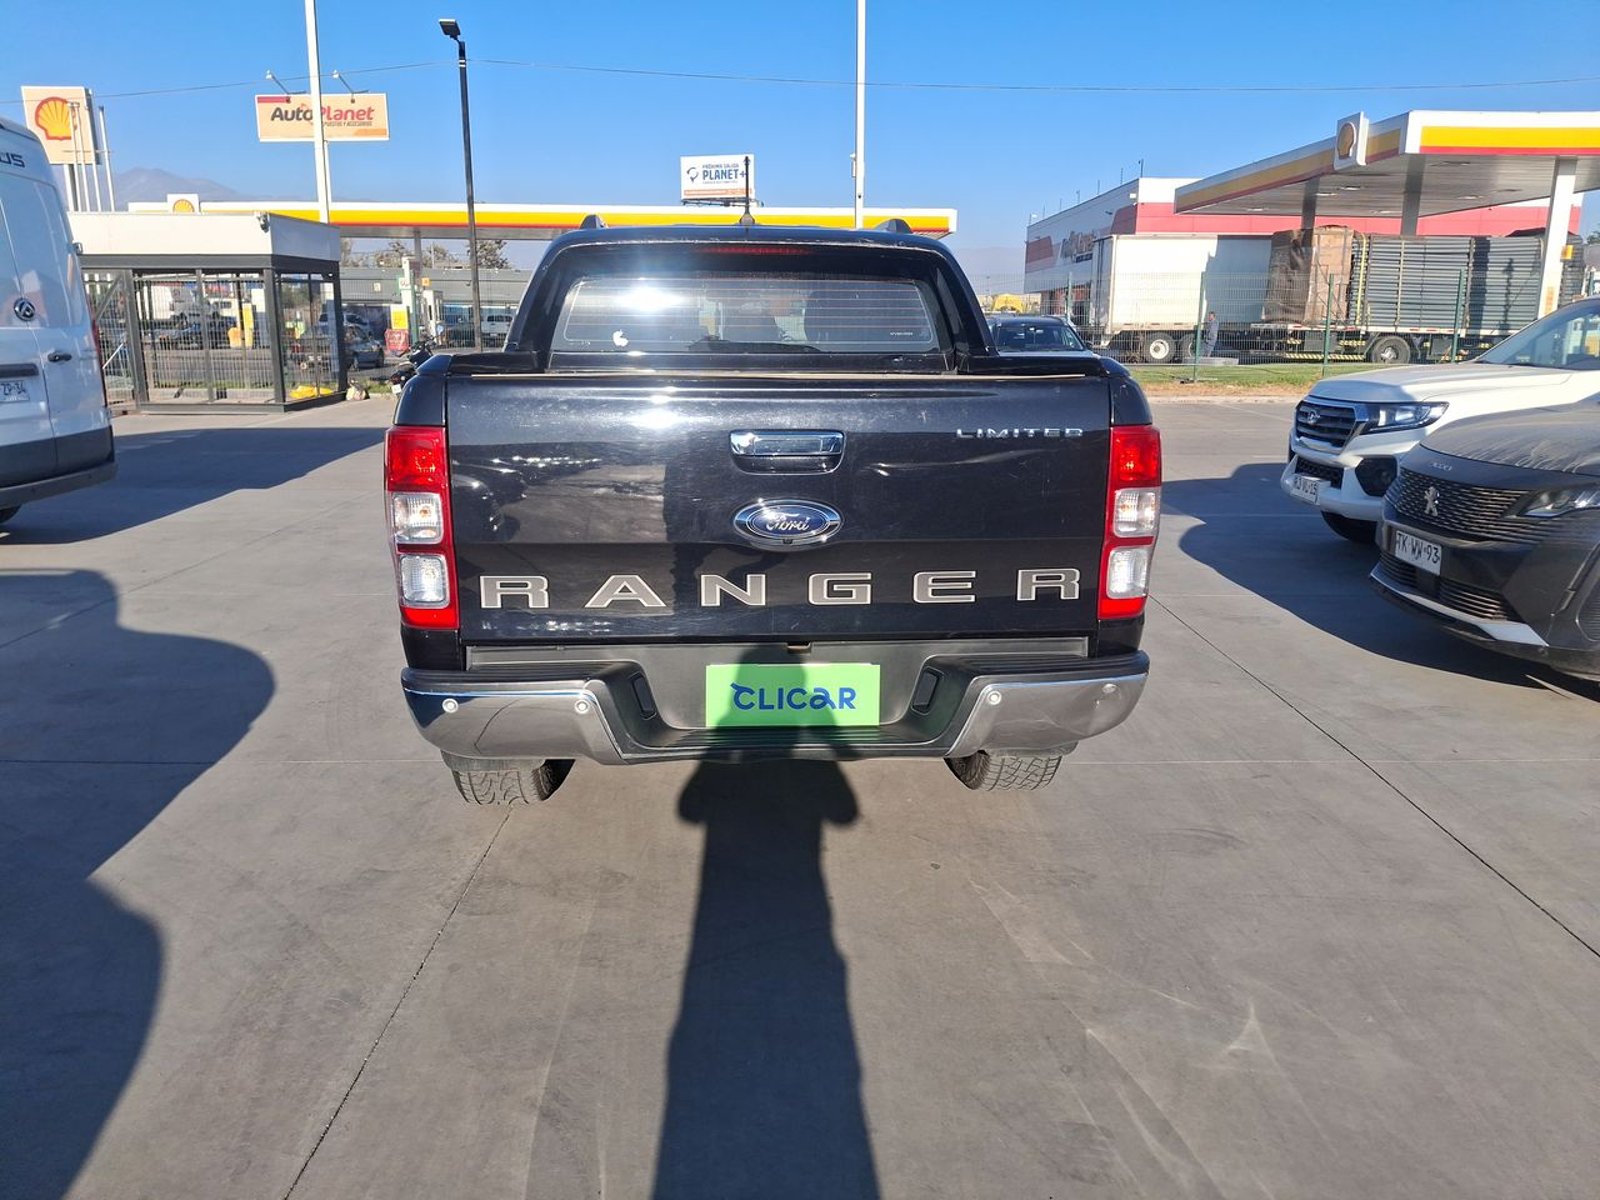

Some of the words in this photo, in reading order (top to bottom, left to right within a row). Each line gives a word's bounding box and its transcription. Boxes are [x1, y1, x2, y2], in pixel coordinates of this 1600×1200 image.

[956, 428, 1083, 438] LIMITED
[764, 511, 811, 531] Ford
[479, 568, 1081, 609] RANGER
